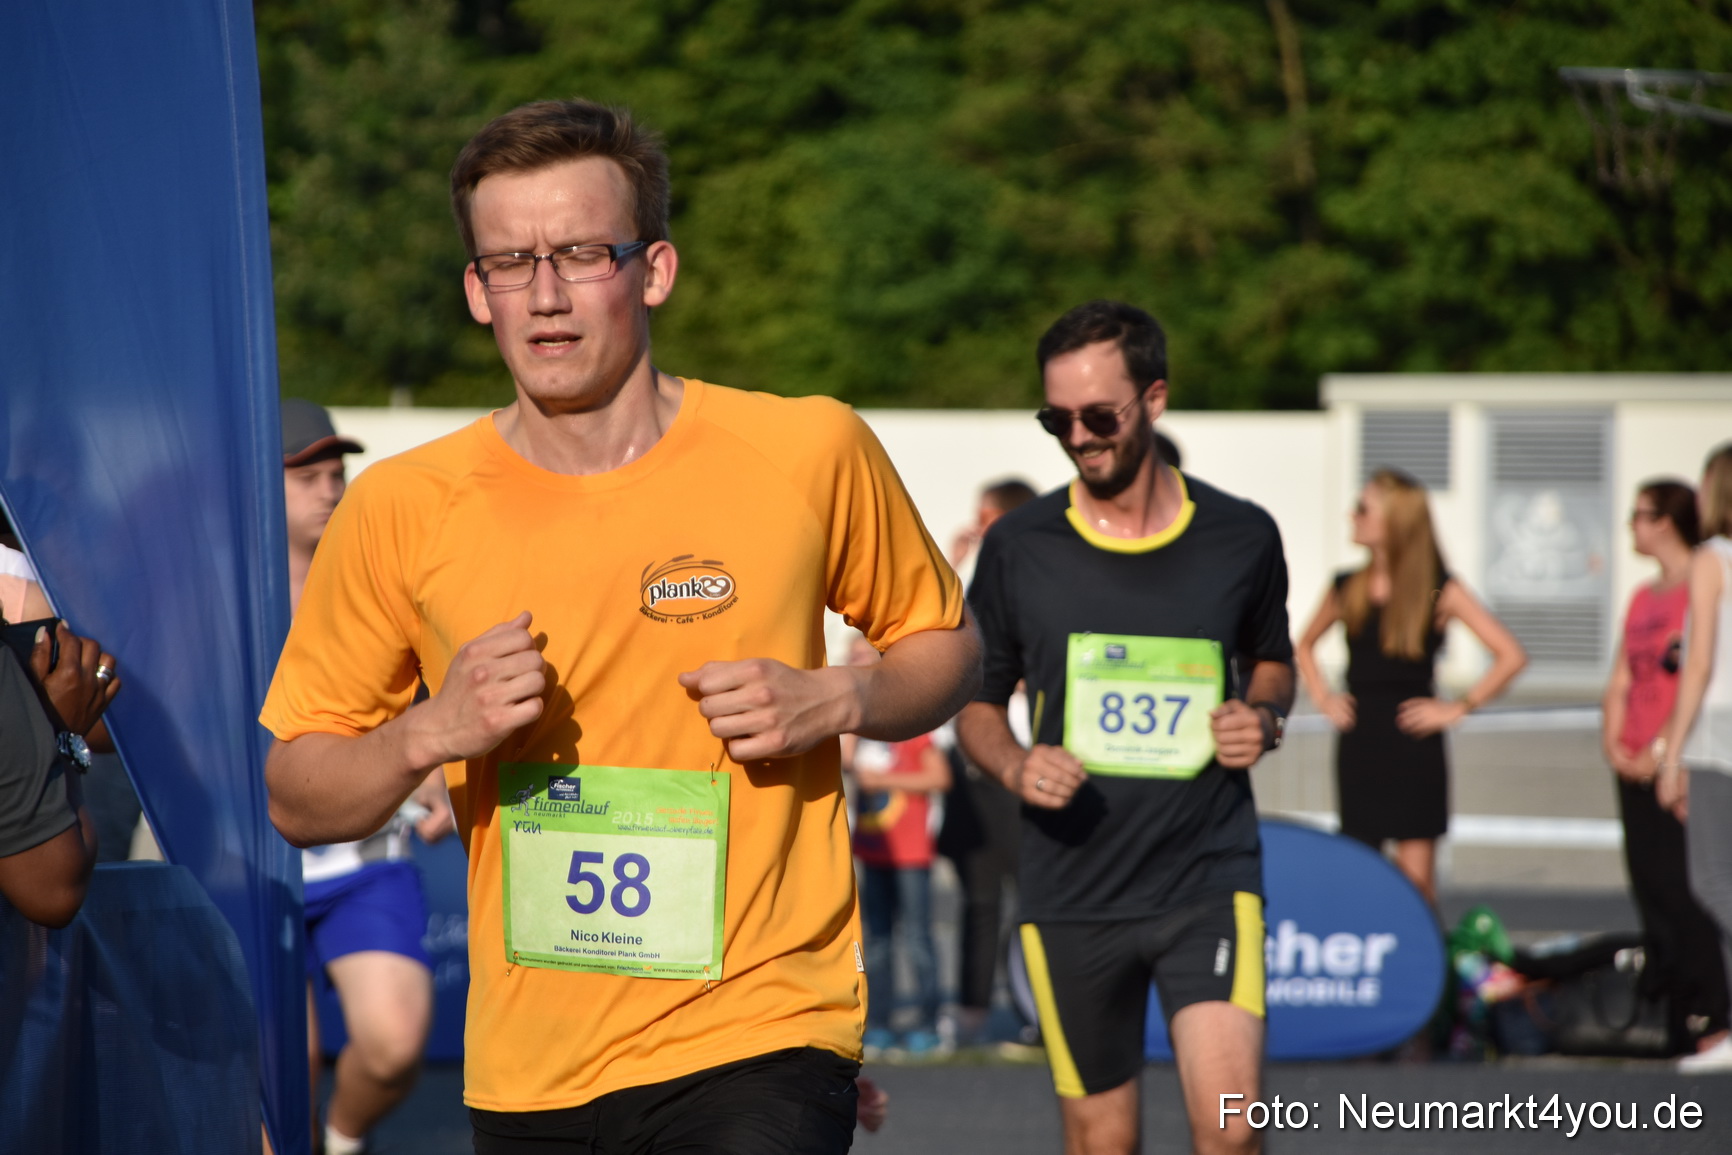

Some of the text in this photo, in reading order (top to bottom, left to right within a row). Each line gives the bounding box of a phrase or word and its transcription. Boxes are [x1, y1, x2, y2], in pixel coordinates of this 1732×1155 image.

[648, 575, 706, 606] plank
[639, 596, 739, 624] Bäckerei Café Konditorei
[1099, 691, 1190, 736] 837
[534, 796, 611, 815] firmenlauf
[611, 811, 654, 825] 2015
[565, 850, 651, 918] 58
[570, 929, 643, 945] Nico Kleine
[554, 945, 581, 953] Bäckerei
[582, 948, 616, 956] Konditorei
[618, 950, 637, 958] Plank
